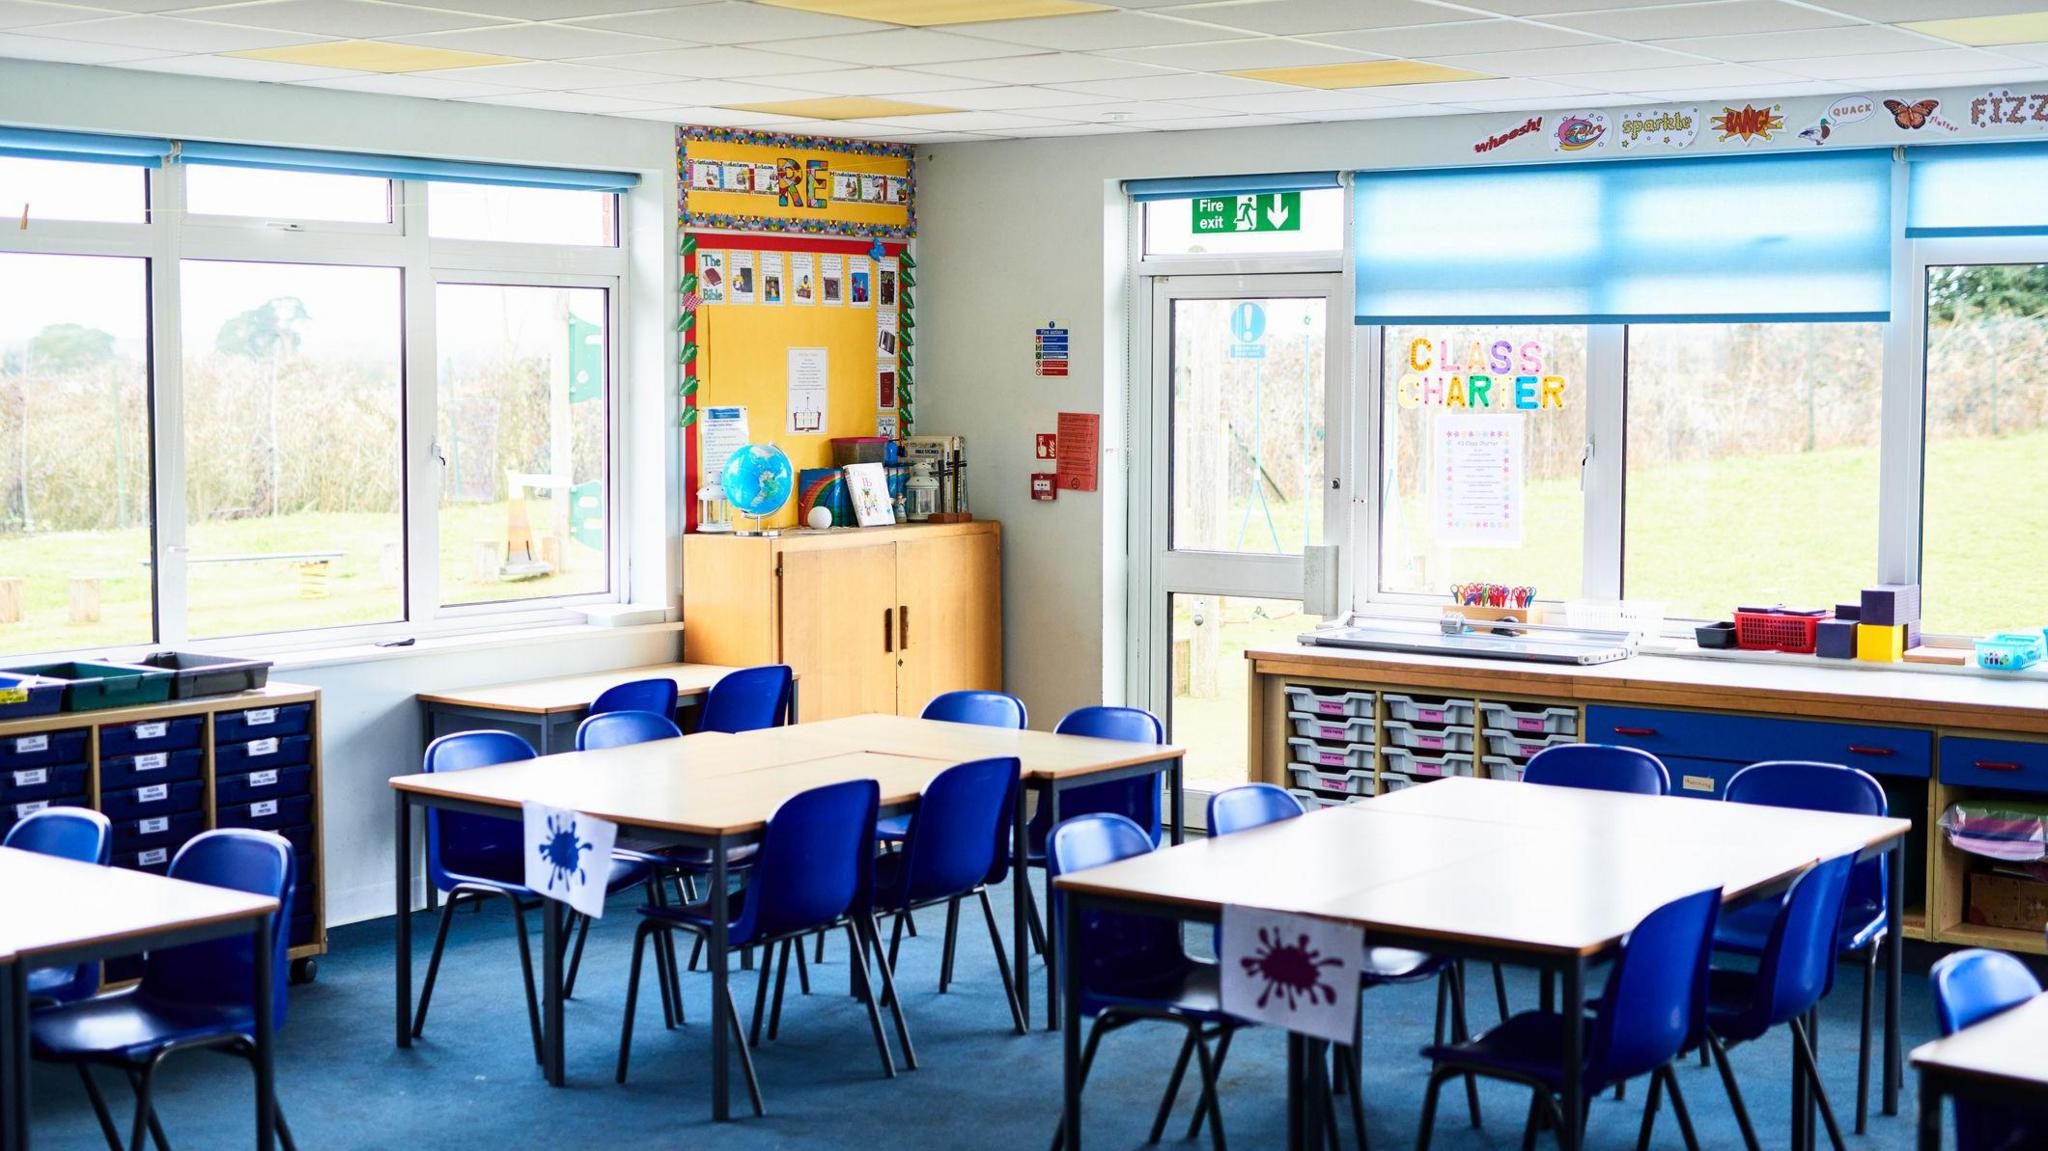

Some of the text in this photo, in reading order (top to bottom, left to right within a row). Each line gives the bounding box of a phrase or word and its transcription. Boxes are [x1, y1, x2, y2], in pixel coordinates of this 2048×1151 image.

[1726, 106, 1771, 133] BANG!
[1832, 103, 1872, 117] QUACK
[1622, 112, 1692, 140] sparkle
[1929, 116, 1959, 132] flutter
[1474, 117, 1543, 153] whoosh!
[777, 158, 828, 208] RE
[1199, 200, 1225, 212] Fire
[1199, 216, 1224, 229] exit
[702, 254, 721, 267] The
[703, 288, 723, 301] Bible
[1410, 338, 1542, 375] CLASS
[1398, 373, 1566, 409] CHARTER
